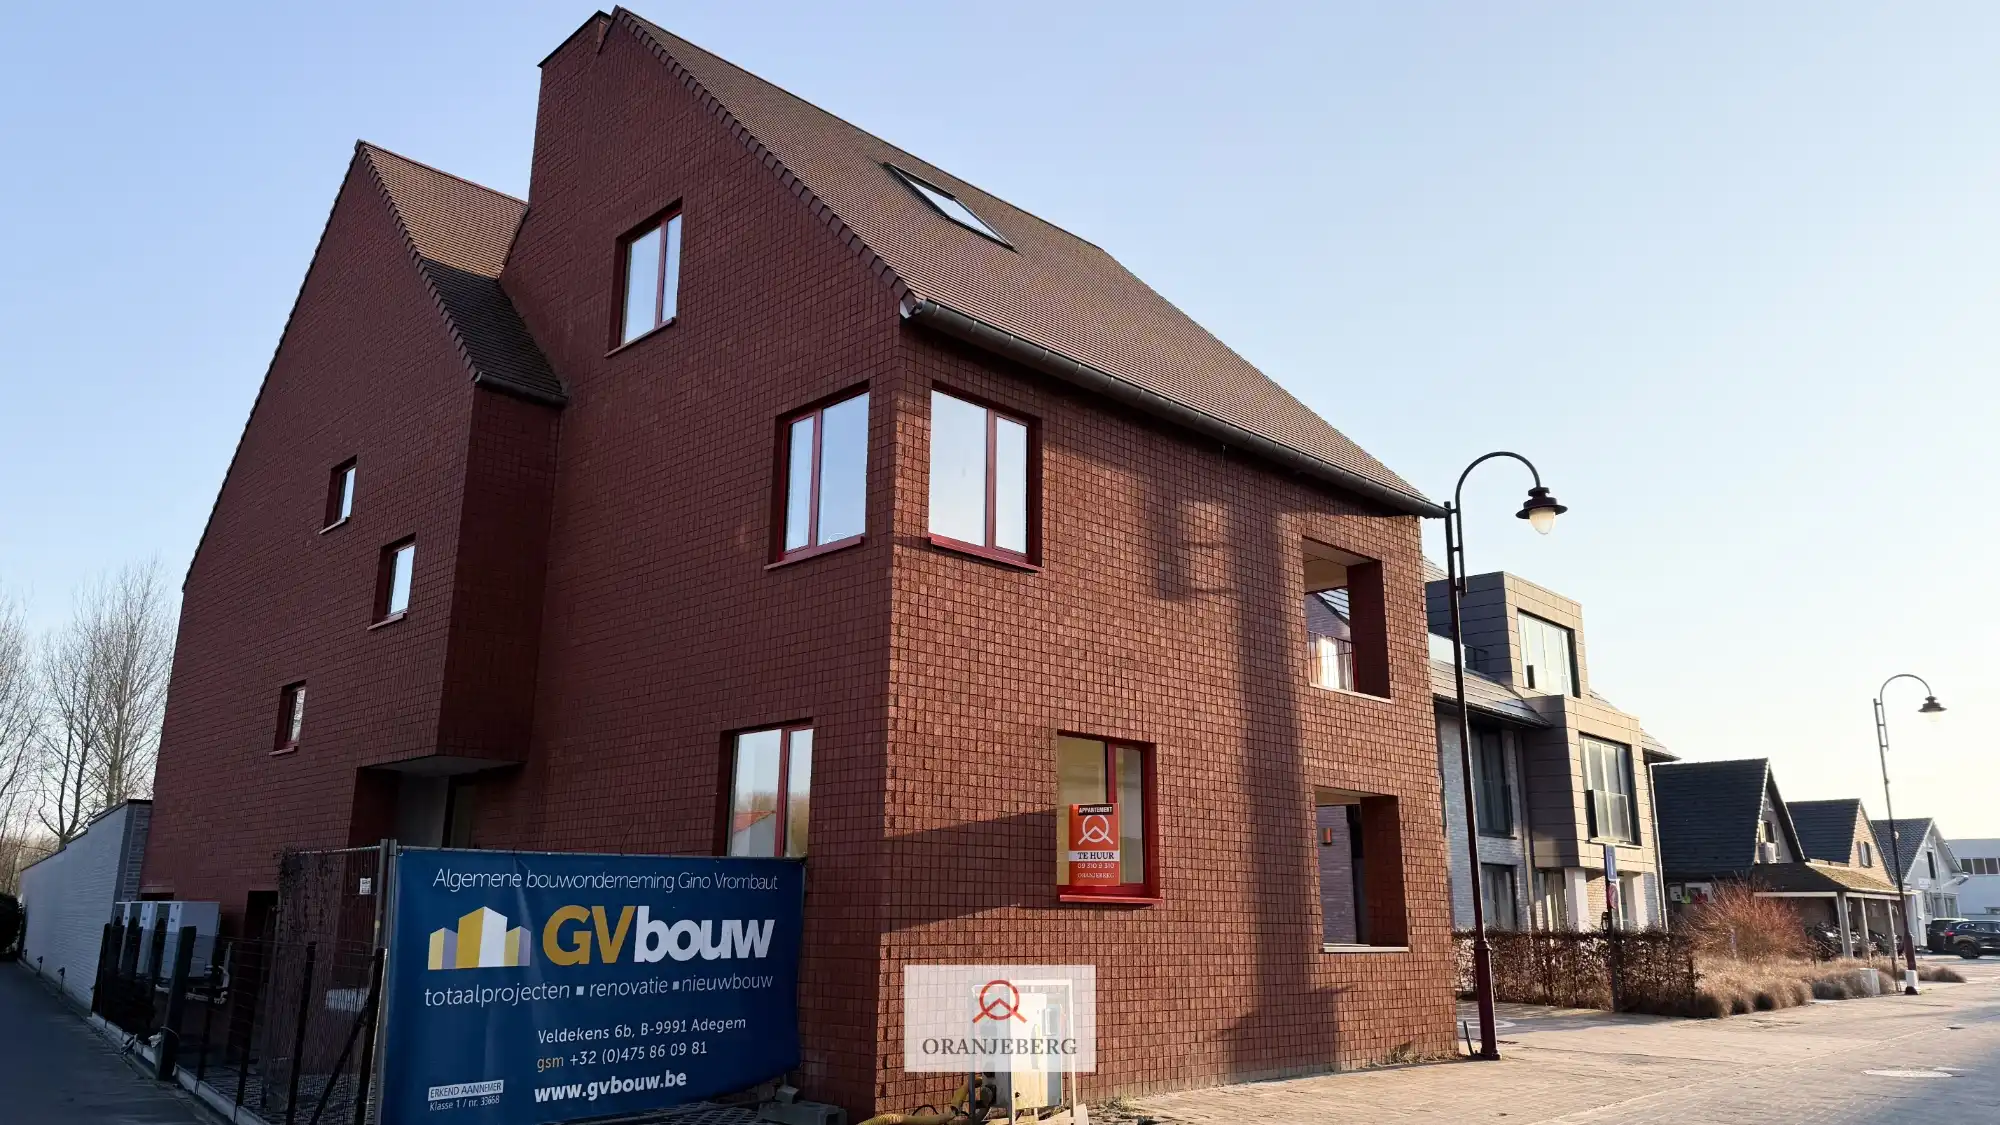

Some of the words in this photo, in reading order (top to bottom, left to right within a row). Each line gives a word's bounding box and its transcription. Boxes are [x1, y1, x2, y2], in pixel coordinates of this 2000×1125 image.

[1077, 851, 1088, 859] TE
[1090, 851, 1114, 859] HUUR
[432, 868, 522, 893] Algemene
[526, 870, 675, 893] bouwonderneming
[678, 872, 711, 889] Gino
[714, 872, 779, 890] Vrombaut
[542, 904, 776, 966] GVbouw
[424, 982, 571, 1008] totaalprojecten
[589, 976, 669, 998] renovatie
[681, 972, 774, 992] nieuwbouw
[537, 1027, 610, 1044] Veldekens
[614, 1024, 635, 1039] 6b,
[640, 1019, 687, 1036] B-9991
[691, 1018, 746, 1034] Adegem
[536, 1056, 564, 1072] gsm
[569, 1051, 596, 1066] +32
[602, 1047, 645, 1065] (0)475
[649, 1044, 666, 1059] 86
[670, 1042, 687, 1056] 09
[691, 1041, 708, 1055] 81
[430, 1087, 460, 1099] ERKEND
[461, 1082, 502, 1095] AANNEMER
[534, 1069, 687, 1103] www.gvbouw.be
[429, 1100, 454, 1112] Klasse
[468, 1099, 478, 1108] nr.
